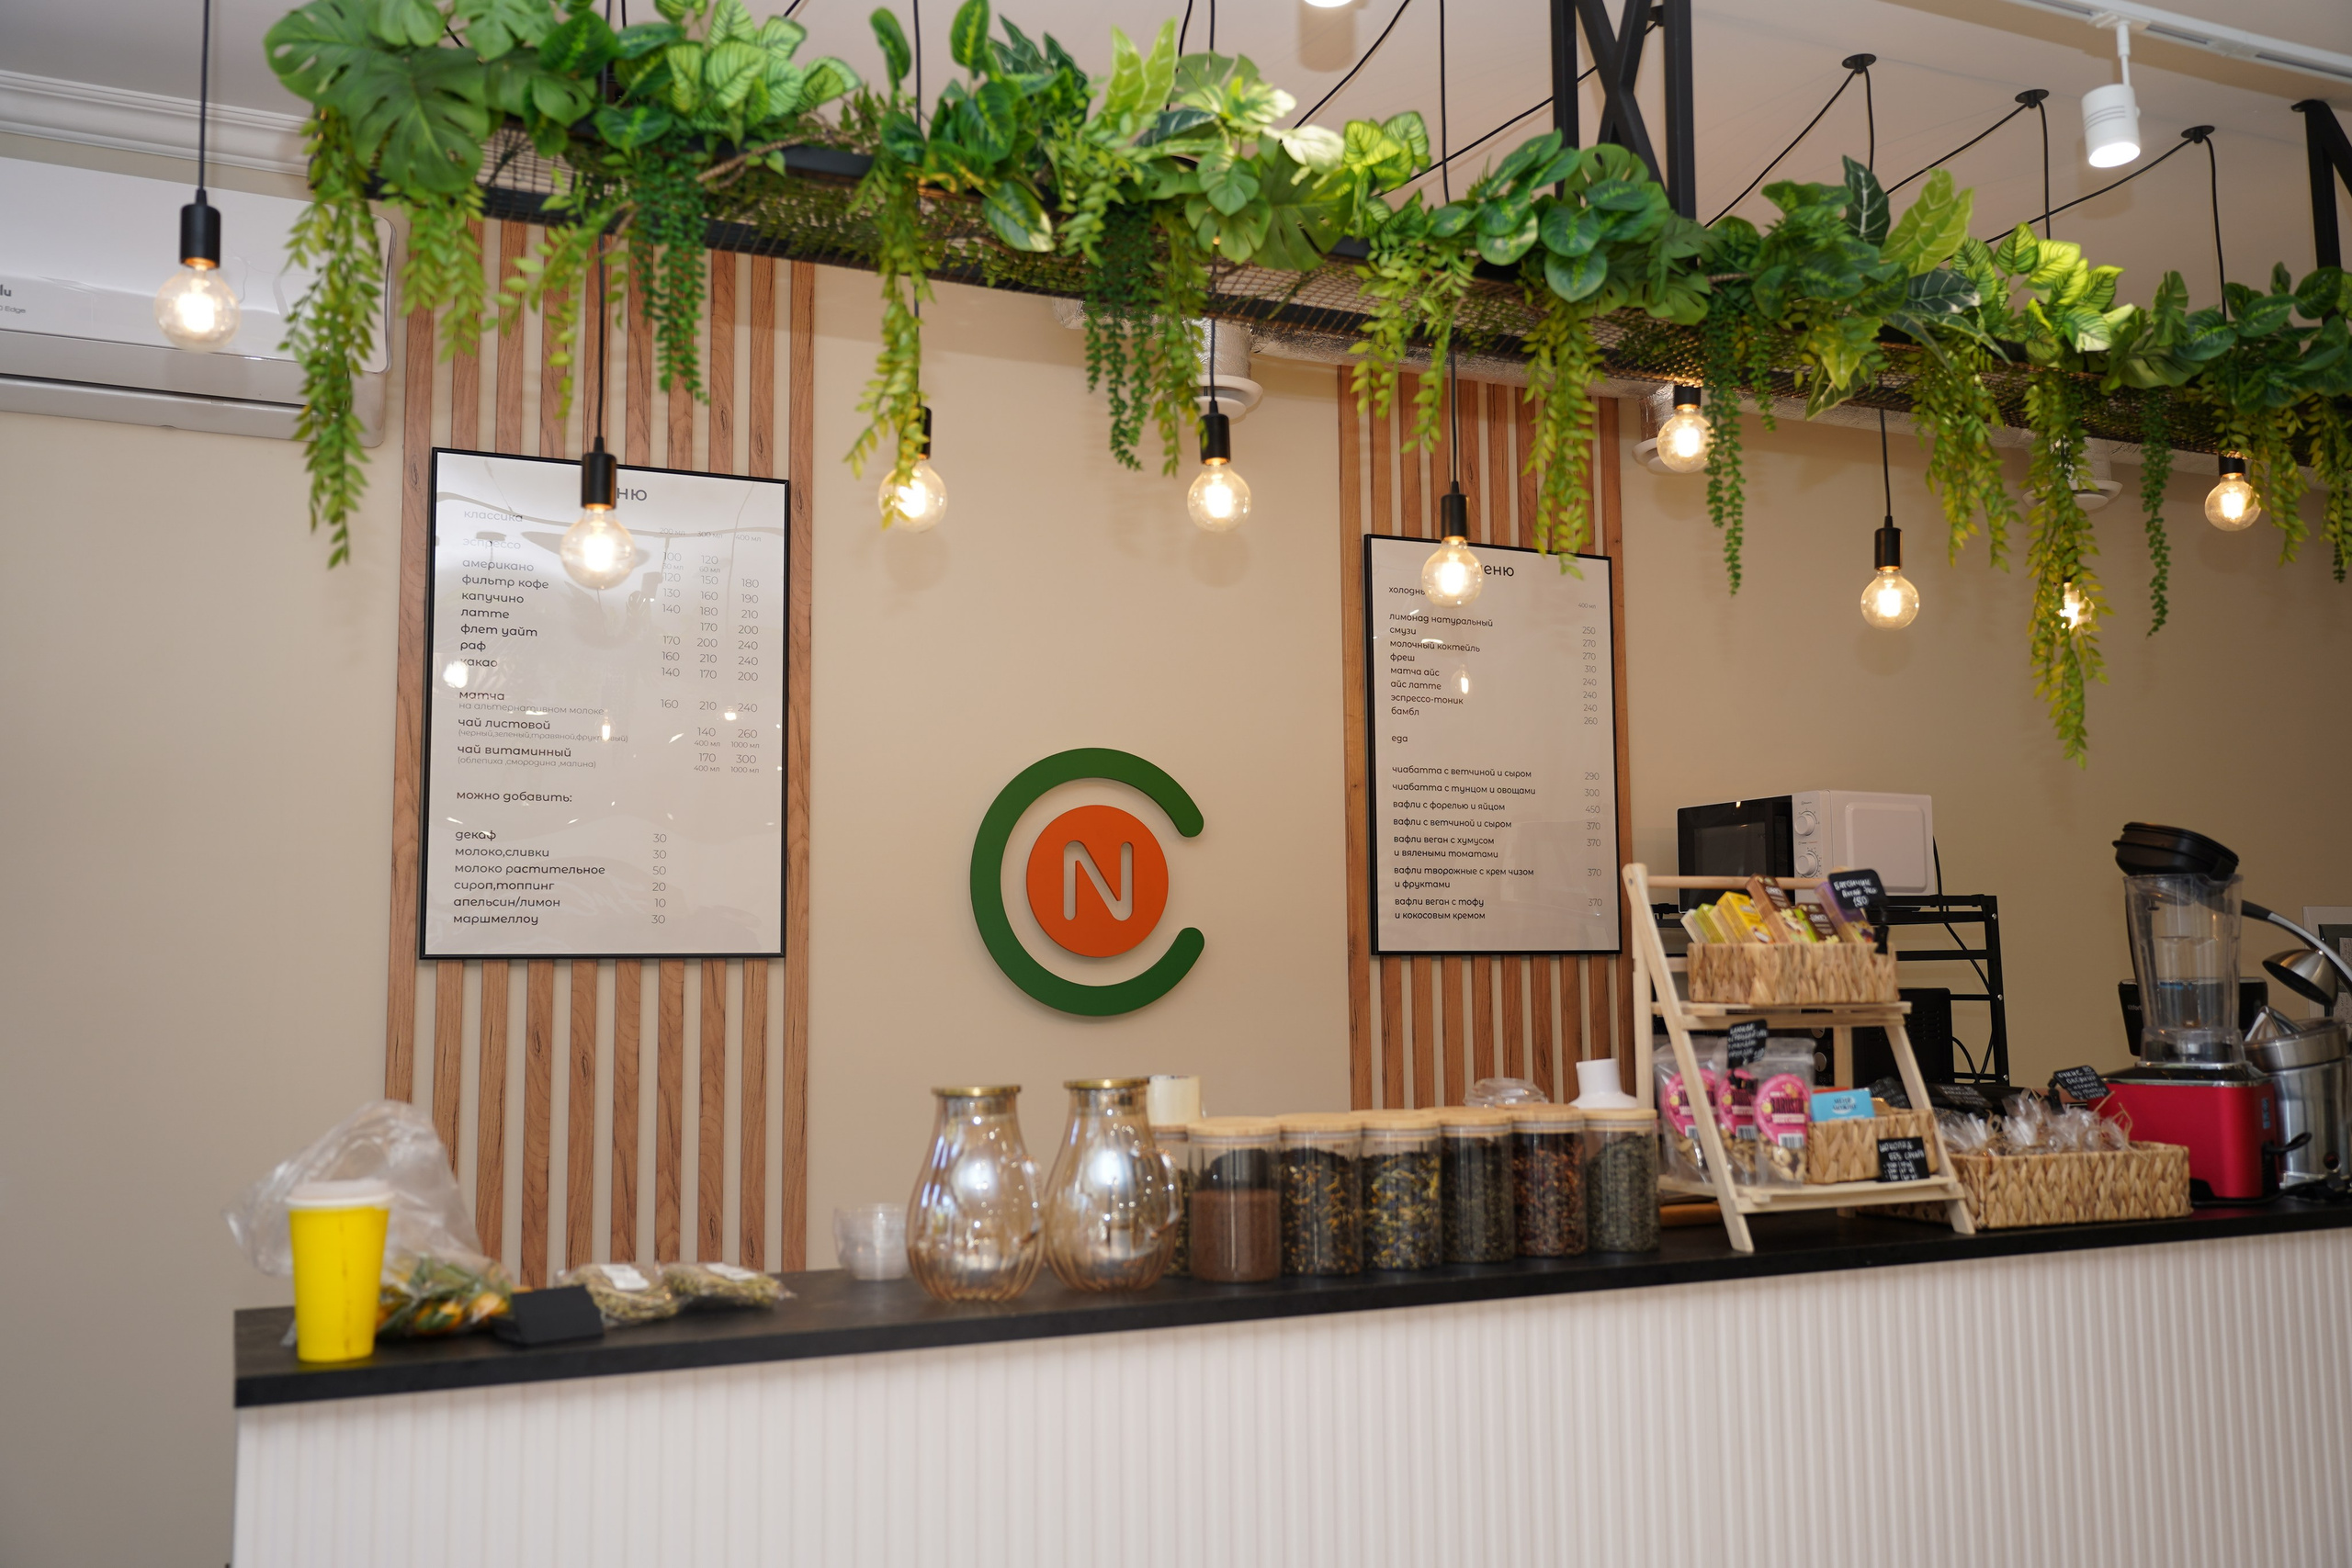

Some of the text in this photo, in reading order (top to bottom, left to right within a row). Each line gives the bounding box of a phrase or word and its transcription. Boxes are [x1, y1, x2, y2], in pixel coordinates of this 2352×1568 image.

[5, 305, 26, 314] Edge
[464, 511, 523, 523] классика
[463, 538, 718, 565] эспрессо 100 120
[462, 558, 759, 588] американо 120 150 180
[1481, 564, 1514, 576] еню
[462, 575, 758, 604] фильтр кофе 130 160 190
[462, 592, 758, 619] капучино 140 180 210
[461, 608, 758, 635] латте 170 200
[1389, 613, 1596, 635] лимонад натуральный 250
[460, 623, 758, 650] флет уайт 170 200 240
[1389, 626, 1416, 636] смузи
[1390, 640, 1434, 649] молочный
[1437, 644, 1480, 652] коктейль
[460, 640, 758, 666] раф 160 210 240
[1390, 653, 1415, 662] фреш
[662, 667, 680, 677] 140
[700, 670, 718, 679] 170
[738, 671, 758, 682] 200
[1424, 668, 1440, 676] айс
[1583, 678, 1597, 686] 240
[1390, 680, 1597, 699] айс латте 240
[459, 691, 757, 712] матча 160 210 240
[1391, 694, 1597, 712] эспрессо-тоник 240
[474, 703, 566, 714] альтернативном
[1391, 706, 1598, 725] бамбл 260
[458, 717, 758, 739] чай листовой 140 260
[458, 744, 757, 763] чай витаминный 170 300
[458, 756, 503, 765] (облепиха
[1392, 765, 1442, 774] чиабатта
[1451, 768, 1495, 776] ветчиной
[1393, 783, 1442, 792] чиабатта
[457, 791, 572, 803] можно добавить:
[1393, 800, 1420, 808] вафли
[1430, 802, 1468, 810] форелью
[1477, 802, 1505, 811] яйцом
[1430, 818, 1475, 827] ветчиной
[455, 829, 667, 843] декаф 30
[1394, 835, 1421, 843] вафли
[455, 848, 666, 859] молоко,сливки 30
[455, 864, 666, 875] молоко растительное 50
[1394, 866, 1422, 874] вафли
[1588, 868, 1601, 876] 370
[454, 881, 666, 892] сироп,топпинг 20
[1063, 840, 1134, 921] N
[1402, 880, 1450, 889] фруктами
[454, 897, 666, 908] апельсин/лимон 10
[1458, 898, 1484, 908] тофу
[1589, 898, 1602, 907] 370
[454, 914, 665, 926] маршмеллоу 30
